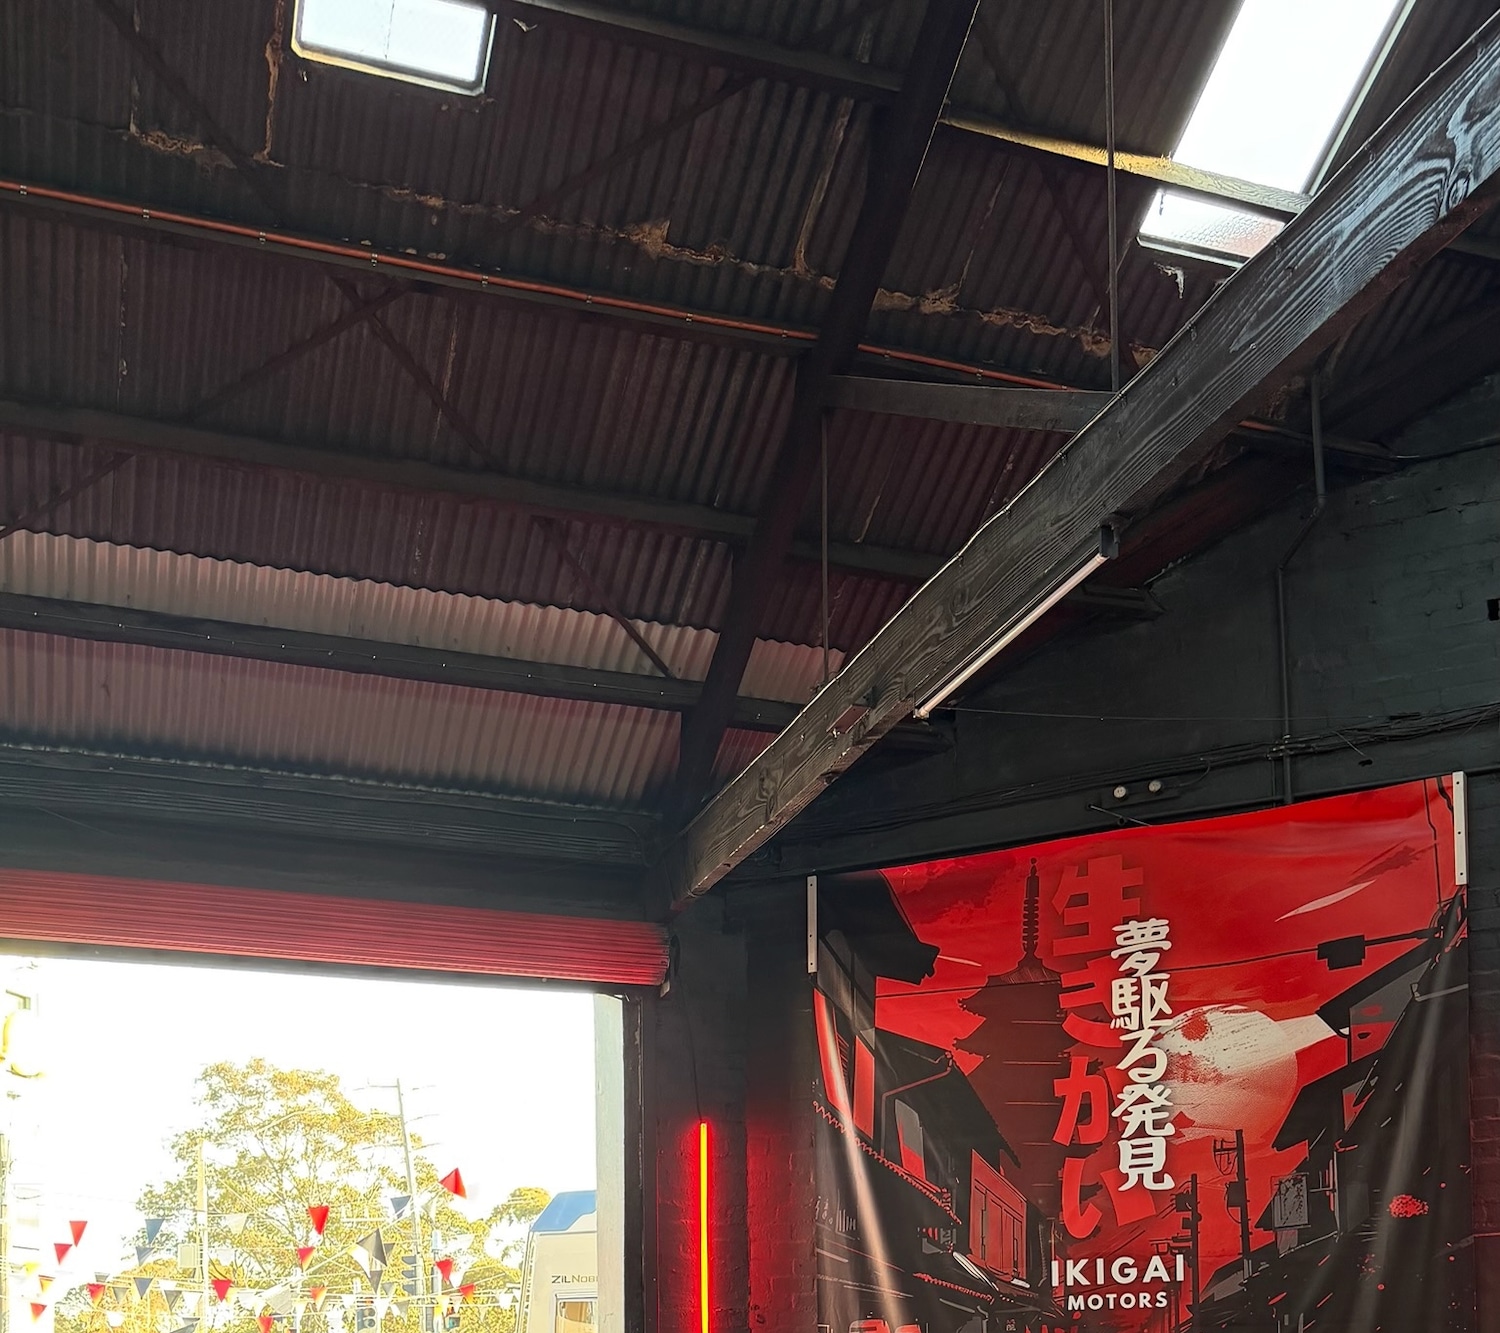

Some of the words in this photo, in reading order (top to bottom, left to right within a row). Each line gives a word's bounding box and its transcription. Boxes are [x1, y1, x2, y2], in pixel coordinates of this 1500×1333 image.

[1110, 918, 1176, 1192] 夢駆る発見
[1051, 1254, 1185, 1287] IKIGAI
[1067, 1291, 1168, 1311] MOTORS
